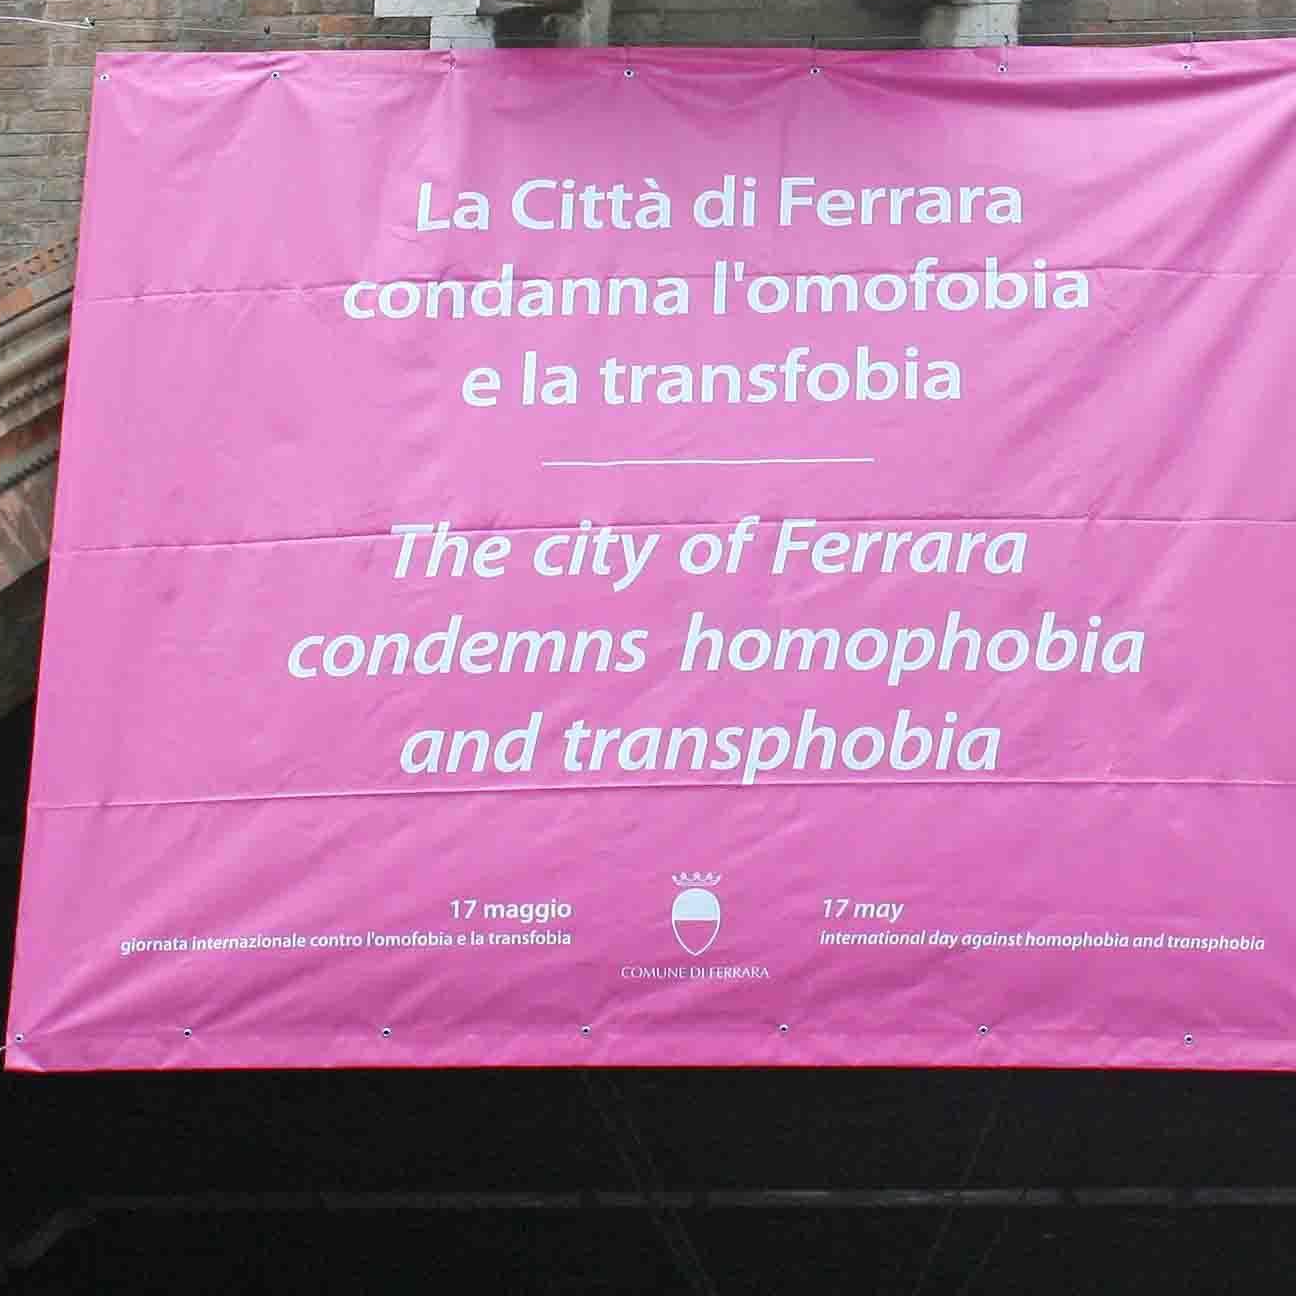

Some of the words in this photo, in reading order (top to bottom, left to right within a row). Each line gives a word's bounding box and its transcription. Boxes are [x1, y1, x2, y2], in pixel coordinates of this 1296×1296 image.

[416, 182, 489, 232] La
[511, 178, 672, 230] Città
[693, 175, 756, 228] di
[780, 176, 1024, 227] Ferrara
[343, 263, 690, 320] condanna
[713, 257, 1090, 314] l'omofobia
[461, 366, 501, 407] e
[522, 351, 578, 405] la
[599, 346, 962, 405] transfobia
[390, 521, 512, 579] The
[533, 519, 660, 592] city
[679, 516, 761, 575] of
[770, 516, 1029, 575] Ferrara
[287, 615, 649, 679] condemns
[680, 612, 1146, 686] homophobia
[399, 713, 543, 774] and
[563, 712, 1002, 785] transphobia
[450, 898, 477, 920] 17
[484, 898, 573, 924] maggio
[821, 898, 850, 919] 17
[853, 900, 905, 924] may
[120, 936, 188, 956] giornata
[192, 933, 306, 951] internazionale
[310, 932, 363, 948] contro
[366, 930, 453, 947] l'omofobia
[457, 934, 467, 947] e
[471, 930, 484, 946] la
[488, 929, 572, 946] transfobia
[819, 930, 926, 946] international
[929, 930, 959, 950] day
[961, 932, 1023, 952] against
[1024, 932, 1129, 953] homophobia
[1132, 934, 1164, 949] and
[1166, 935, 1266, 953] transphobia
[620, 966, 687, 979] COMUNE
[689, 966, 704, 979] DI
[708, 966, 771, 979] FERRARA
